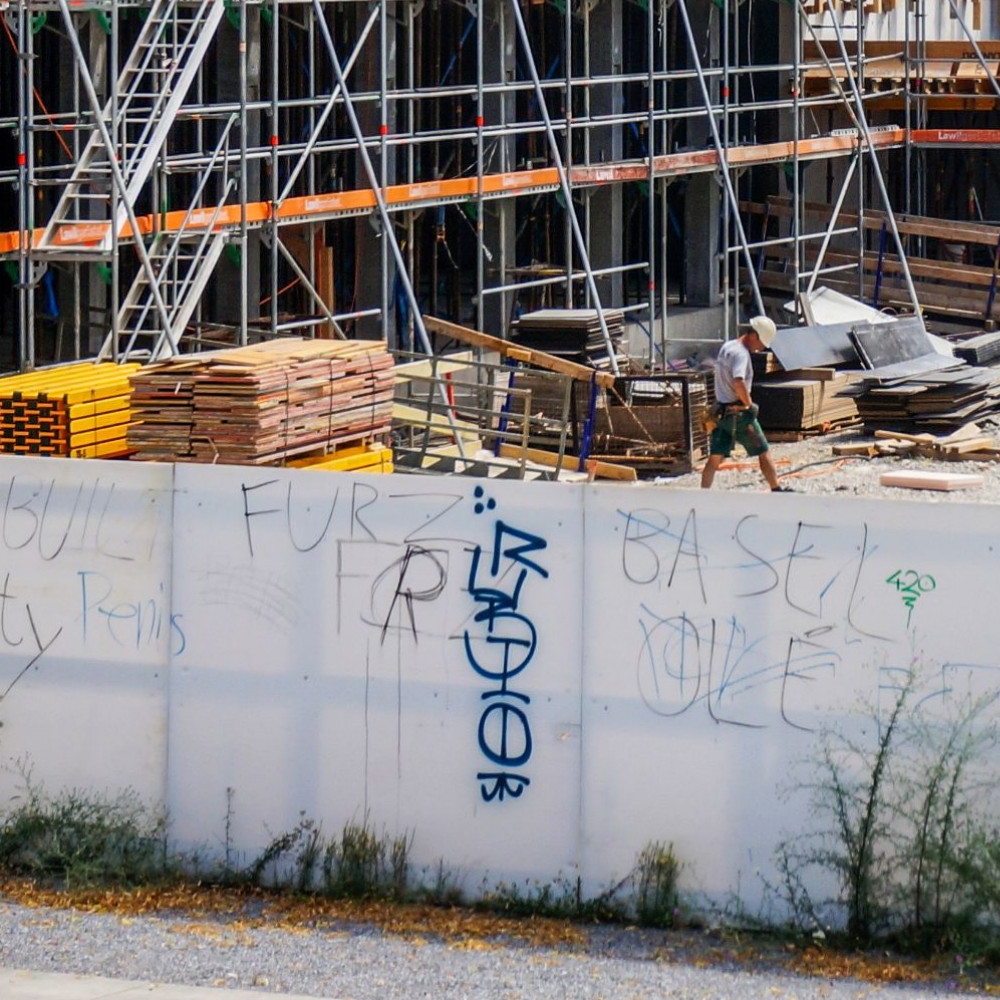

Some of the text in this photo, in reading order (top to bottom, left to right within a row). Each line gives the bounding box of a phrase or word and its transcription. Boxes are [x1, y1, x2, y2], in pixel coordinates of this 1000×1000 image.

[241, 479, 470, 558] FURZ
[77, 570, 186, 656] Penis
[622, 508, 896, 643] BASEL
[885, 569, 936, 593] 420
